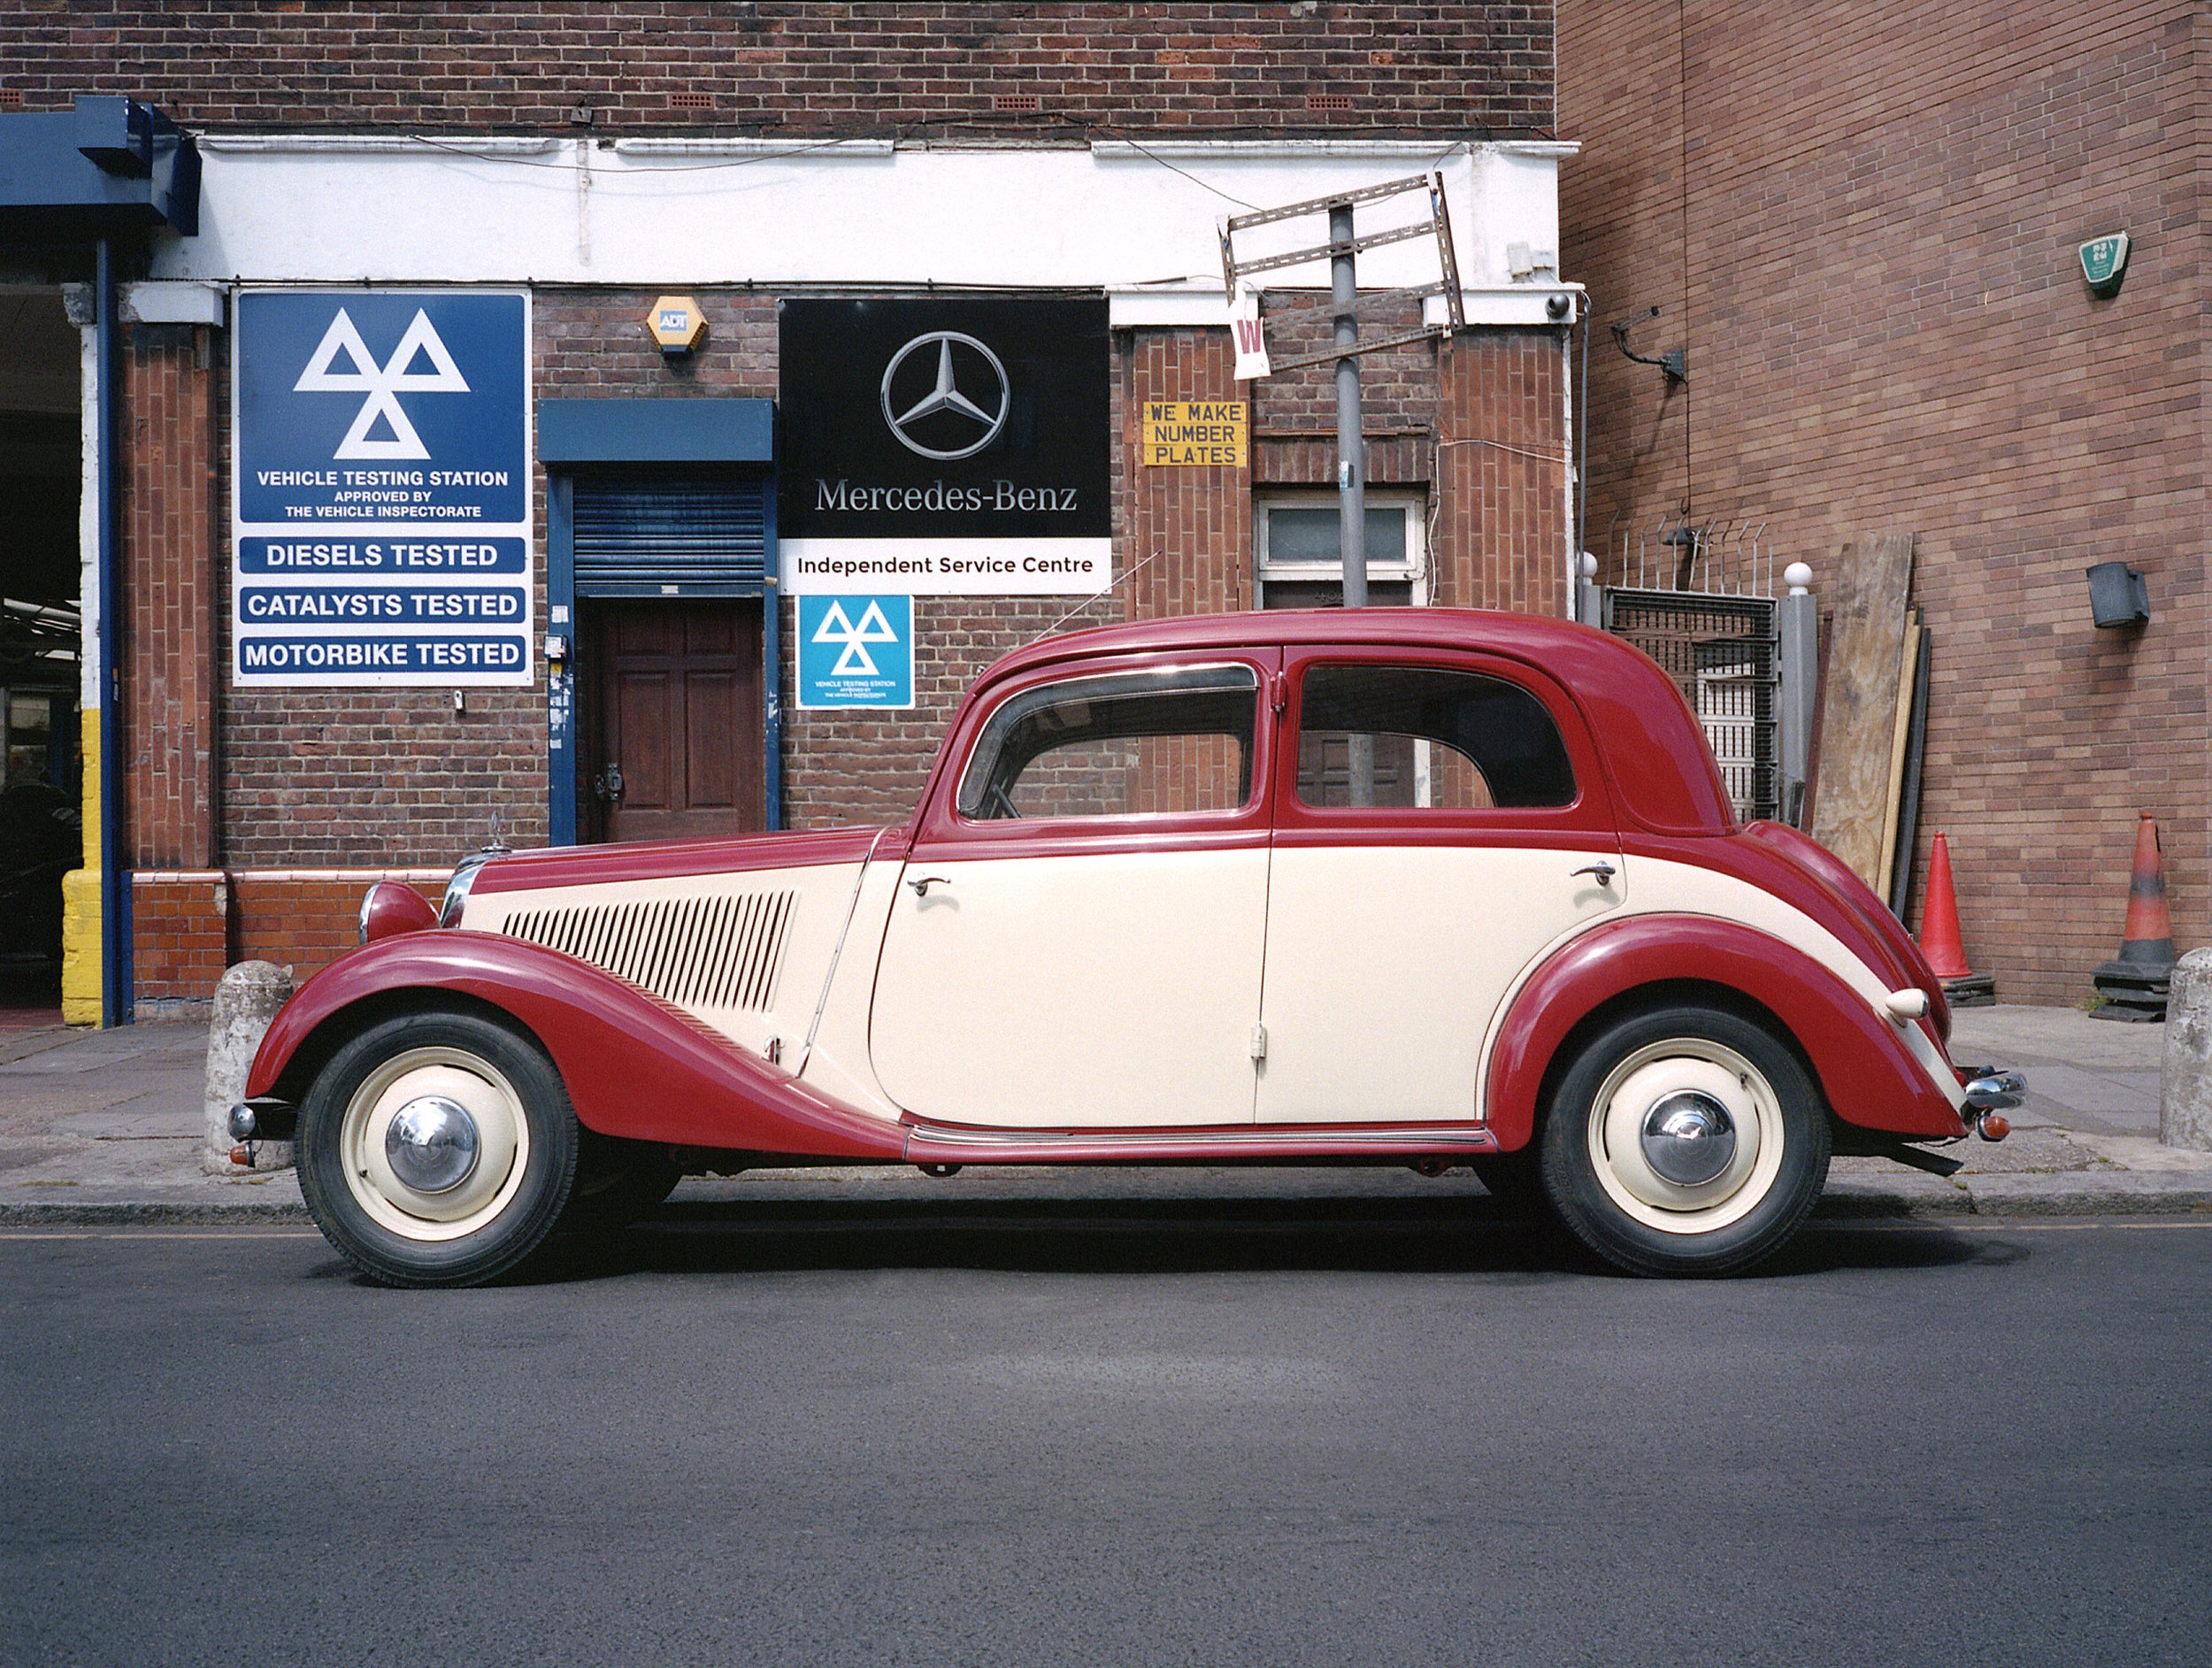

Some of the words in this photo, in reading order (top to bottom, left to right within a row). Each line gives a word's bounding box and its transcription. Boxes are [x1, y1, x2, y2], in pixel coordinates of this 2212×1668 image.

[660, 313, 687, 328] ADT
[1237, 319, 1261, 354] W
[1151, 404, 1176, 420] WE
[1188, 404, 1240, 420] MAKE
[1155, 426, 1234, 442] NUMBER
[1156, 446, 1236, 463] PLATES
[257, 471, 337, 486] VEHICLE
[343, 471, 423, 486] TESTING
[429, 471, 508, 486] STATION
[334, 491, 409, 502] APPROVED
[413, 491, 432, 502] BY
[815, 478, 1077, 511] Mercedes-Benz
[285, 506, 312, 517] THE
[316, 506, 373, 517] VEHICLE
[378, 506, 481, 517] INSPECTORATE
[266, 544, 382, 566] DIESELS
[390, 544, 497, 566] TESTED
[797, 557, 933, 577] Independent
[940, 557, 1016, 573] Service
[1023, 557, 1094, 573] Centre
[248, 594, 403, 616] CATALYSTS
[411, 594, 518, 616] TESTED
[245, 643, 408, 666] MOTORBIKE
[416, 642, 519, 665] TESTED
